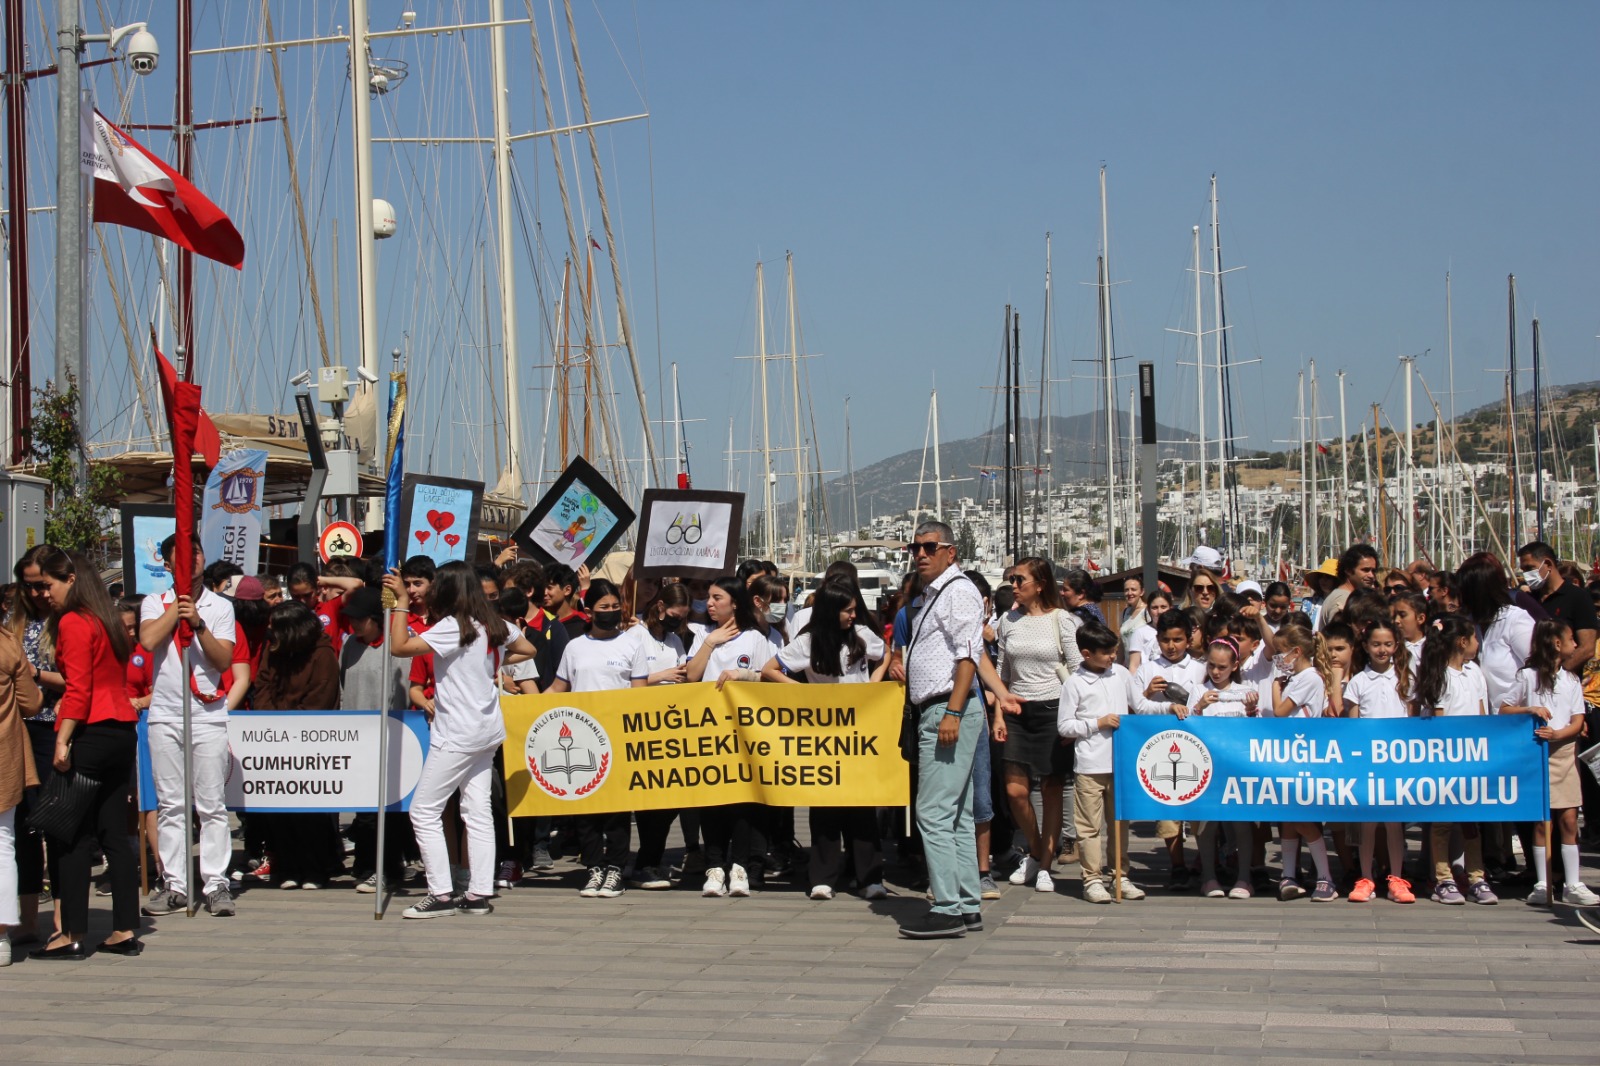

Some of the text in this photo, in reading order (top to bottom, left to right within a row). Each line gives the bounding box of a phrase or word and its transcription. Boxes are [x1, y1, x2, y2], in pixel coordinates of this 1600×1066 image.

[241, 727, 290, 743] MUĞLA
[301, 729, 360, 743] BODRUM
[533, 715, 549, 735] MİLLİ
[549, 709, 574, 721] EĞİTİM
[575, 713, 606, 746] BAKANLIĞI
[622, 704, 718, 735] MUĞLA
[737, 706, 856, 728] BODRUM
[625, 729, 879, 762] MESLEKİ ve TEKNİK
[1249, 733, 1343, 764] MUĞLA
[1371, 737, 1489, 764] BODRUM
[241, 752, 352, 772] CUMHURİYET
[628, 760, 841, 791] ANADOLU LİSESİ
[241, 780, 344, 796] ORTAOKULU
[1221, 770, 1518, 806] ATATÜRK İLKOKULU
